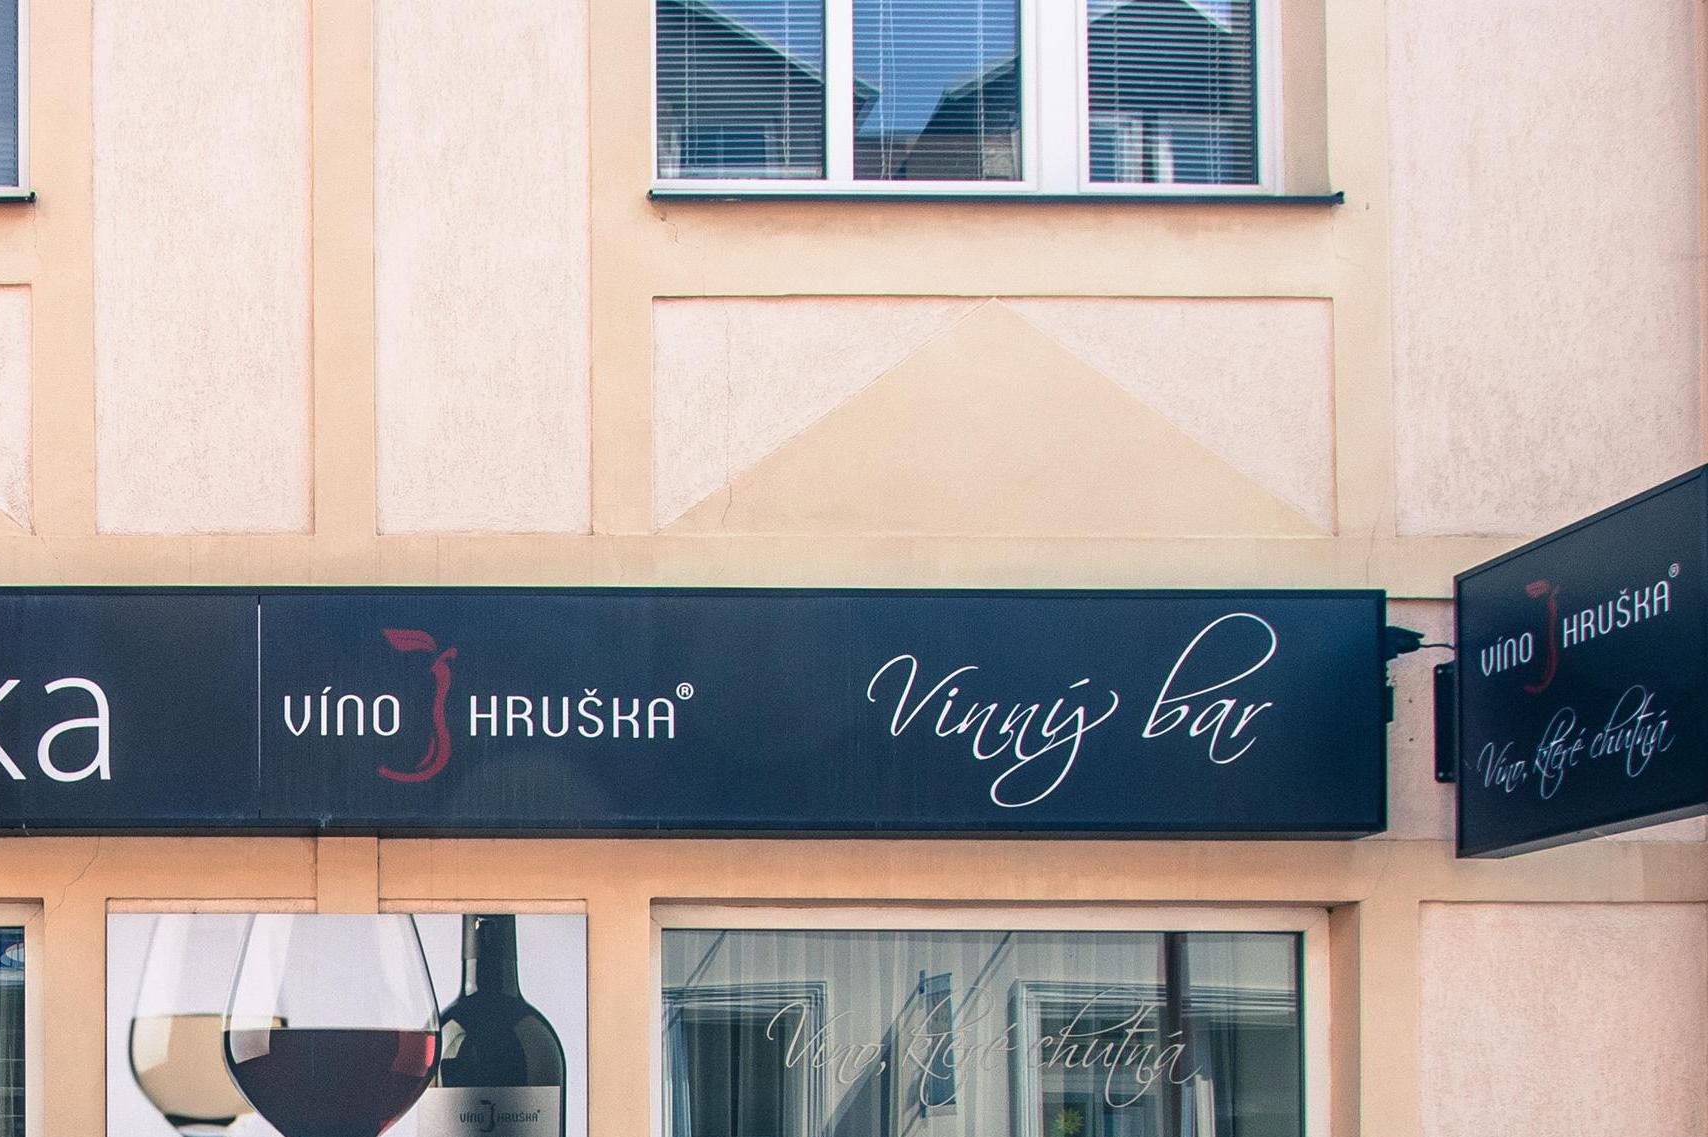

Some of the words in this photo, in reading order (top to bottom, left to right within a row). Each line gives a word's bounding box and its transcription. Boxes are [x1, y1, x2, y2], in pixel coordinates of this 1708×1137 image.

[1481, 633, 1533, 677] VÍNO
[283, 686, 401, 737] VÍNO
[867, 654, 1119, 808] Vinný
[1141, 612, 1278, 764] bar
[1029, 986, 1202, 1108] chutná
